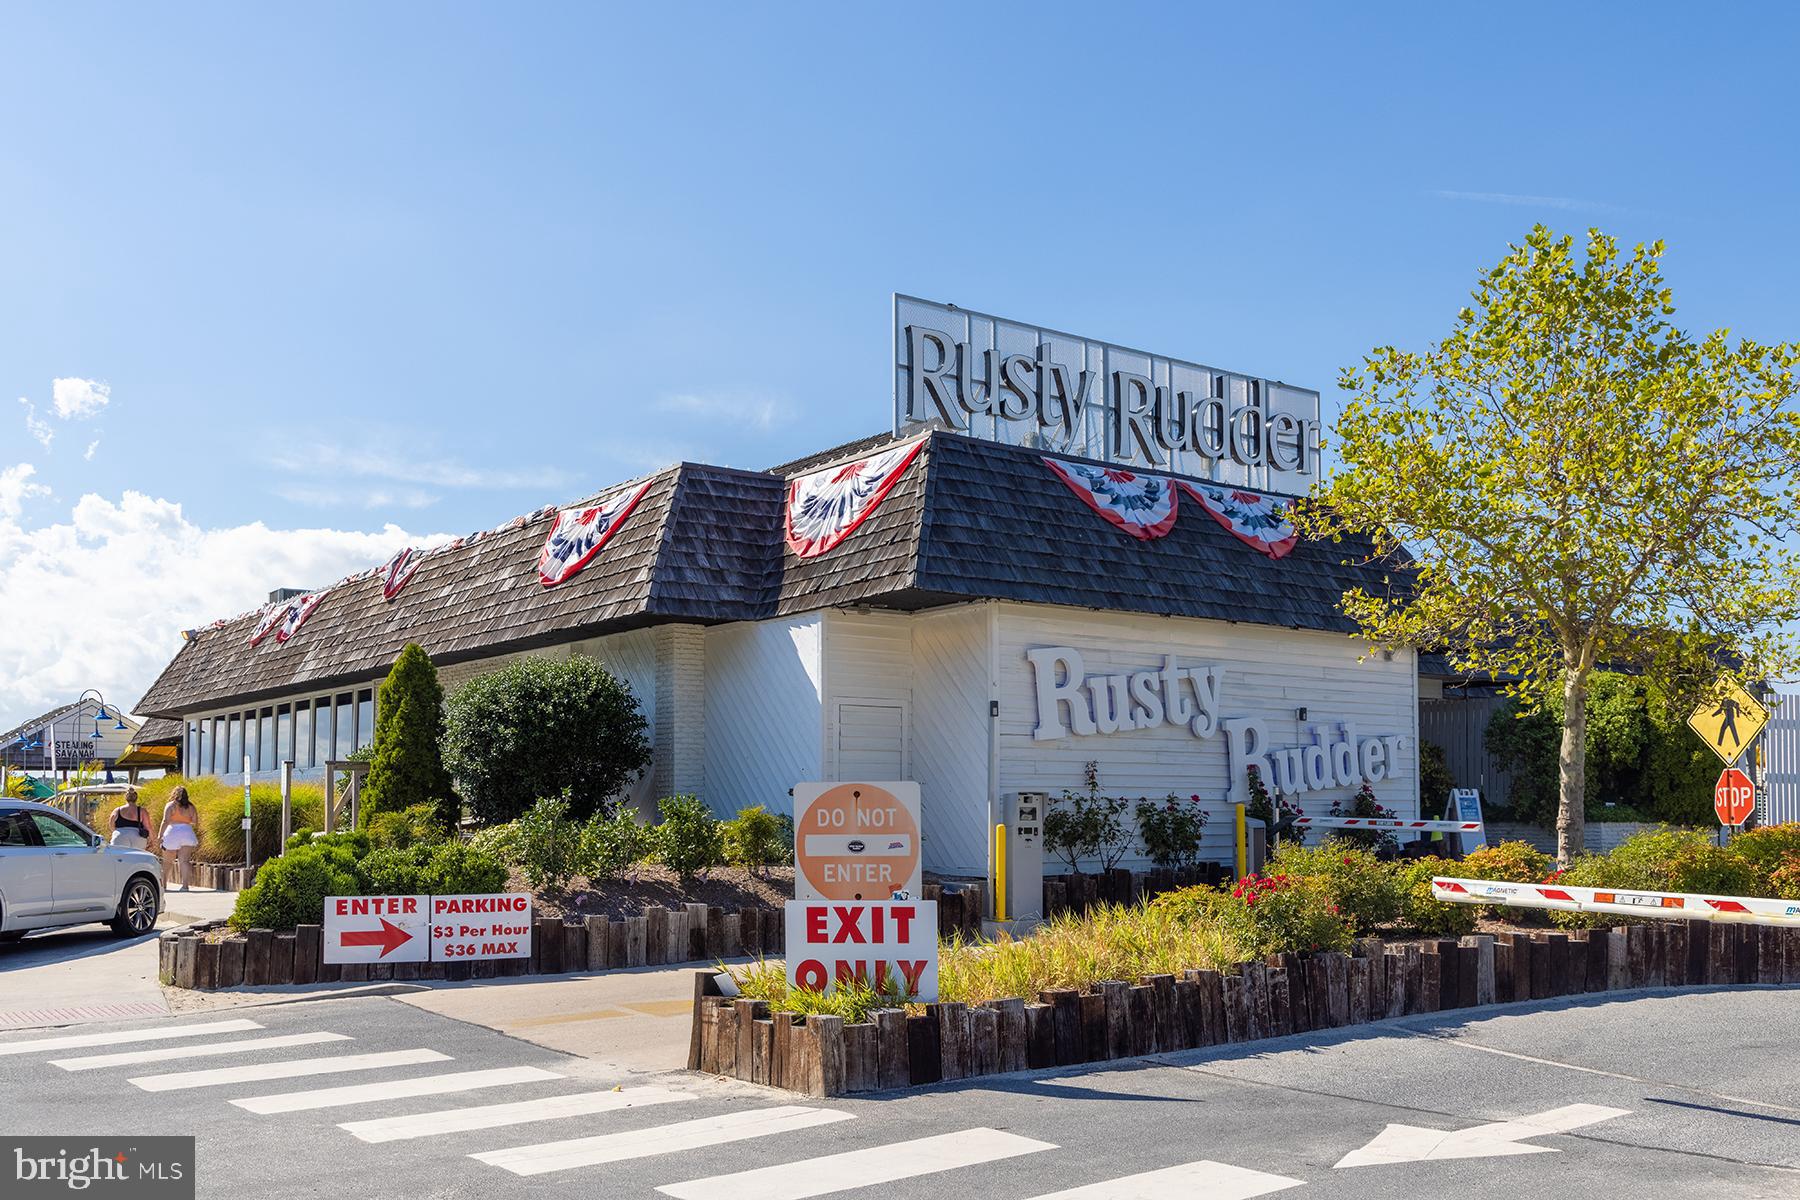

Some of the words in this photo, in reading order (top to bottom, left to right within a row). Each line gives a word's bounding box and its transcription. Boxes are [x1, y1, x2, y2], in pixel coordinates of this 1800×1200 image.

[905, 325, 1096, 452] Rusty
[1113, 370, 1321, 475] Rudder
[1026, 647, 1226, 740] Rusty
[55, 741, 94, 750] STEALING
[1222, 718, 1409, 803] Rudder
[1716, 786, 1751, 808] STOP
[817, 808, 845, 828] DO
[857, 807, 897, 828] NOT
[823, 863, 893, 883] ENTER
[336, 897, 418, 916] ENTER
[434, 897, 528, 915] PARKING
[433, 926, 454, 939] $3
[459, 924, 487, 937] Per
[492, 923, 530, 936] Hour
[806, 906, 916, 944] EXIT
[444, 943, 476, 957] $36
[481, 941, 518, 955] MAX
[795, 959, 929, 996] ONLY
